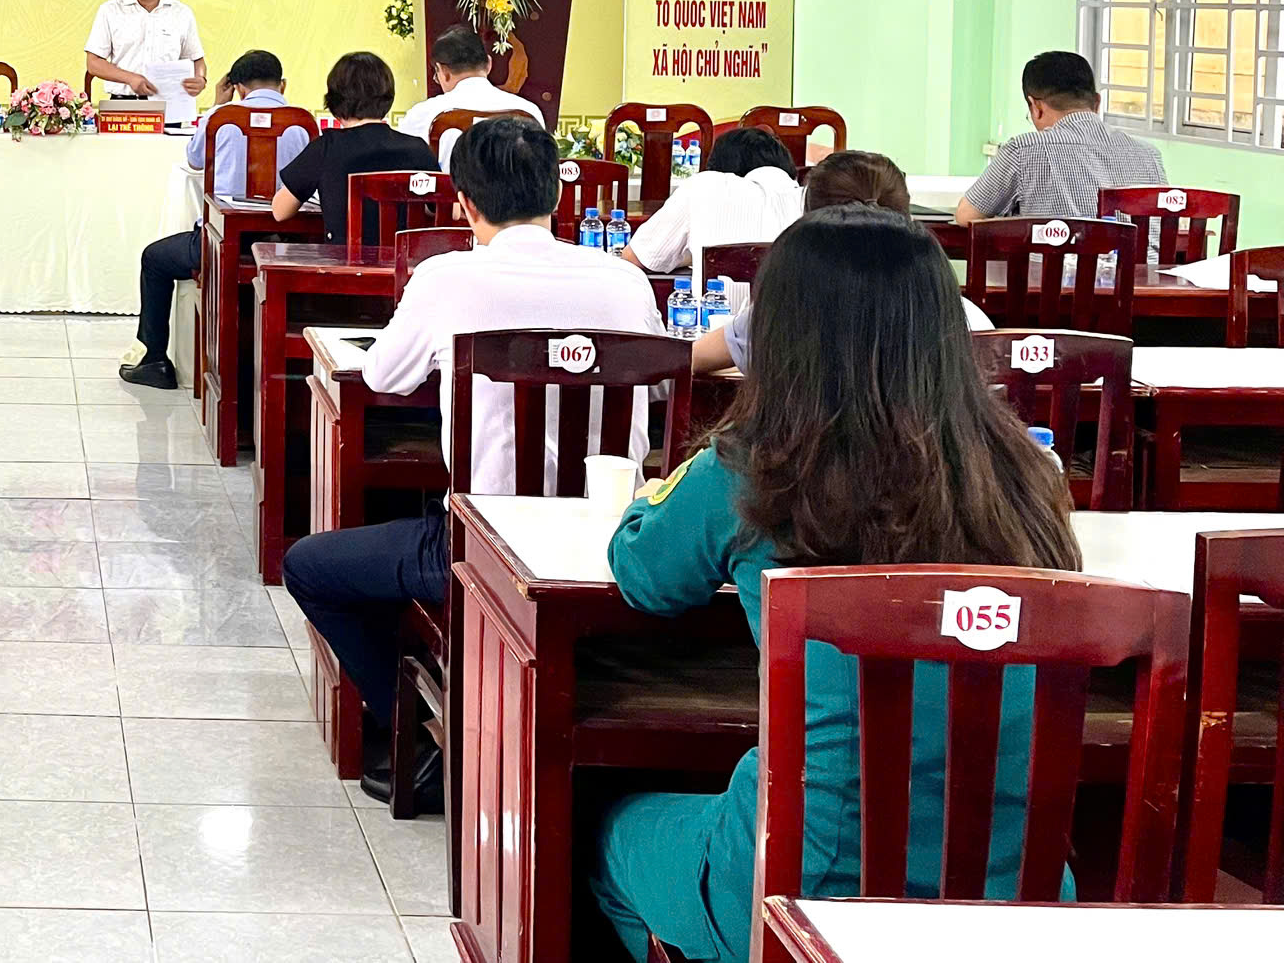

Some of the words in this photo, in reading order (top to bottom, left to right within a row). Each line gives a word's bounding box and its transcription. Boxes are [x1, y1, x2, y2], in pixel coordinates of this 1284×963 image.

[738, 1, 767, 29] NAM
[652, 43, 668, 76] XÃ
[672, 43, 692, 83] HỘI
[696, 40, 720, 77] CHỦ
[561, 166, 579, 177] 083
[411, 178, 430, 189] 077
[1165, 195, 1185, 206] 082
[1045, 227, 1067, 239] 086
[560, 346, 592, 363] 067
[1020, 345, 1049, 363] 033
[956, 603, 1011, 632] 055
